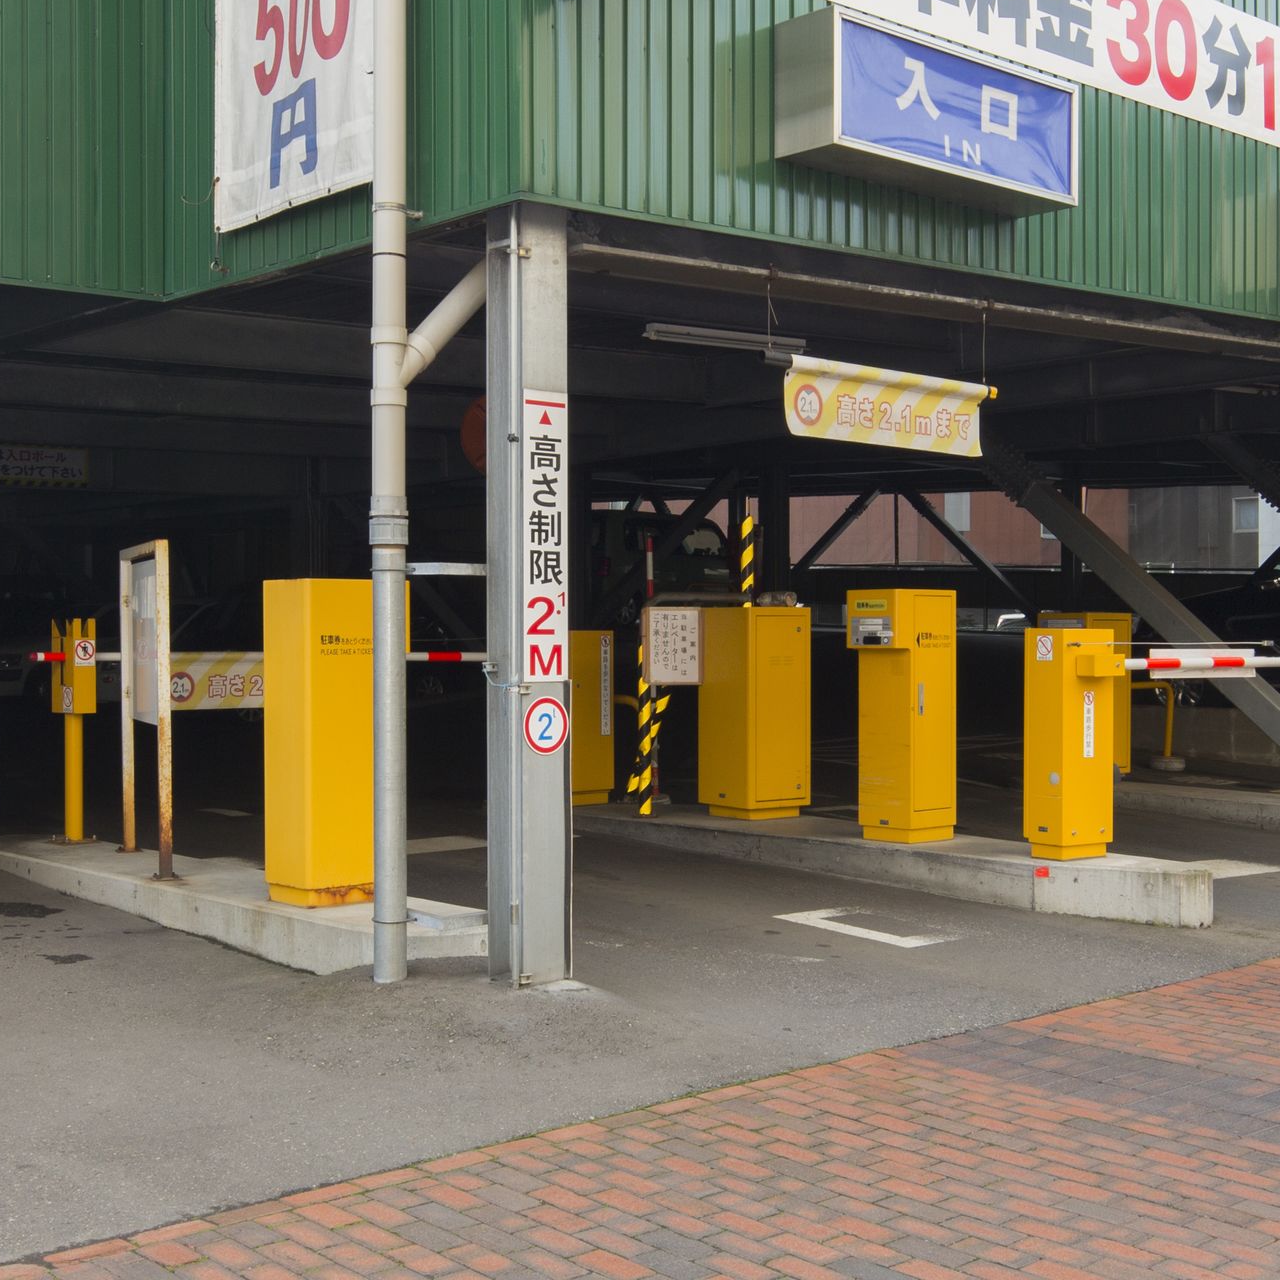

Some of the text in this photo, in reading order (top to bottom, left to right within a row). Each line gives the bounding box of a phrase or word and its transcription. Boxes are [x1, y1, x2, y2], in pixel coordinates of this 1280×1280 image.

[896, 56, 1019, 142] 入口
[943, 134, 983, 167] IN
[836, 393, 972, 440] 高さ2.1mまで
